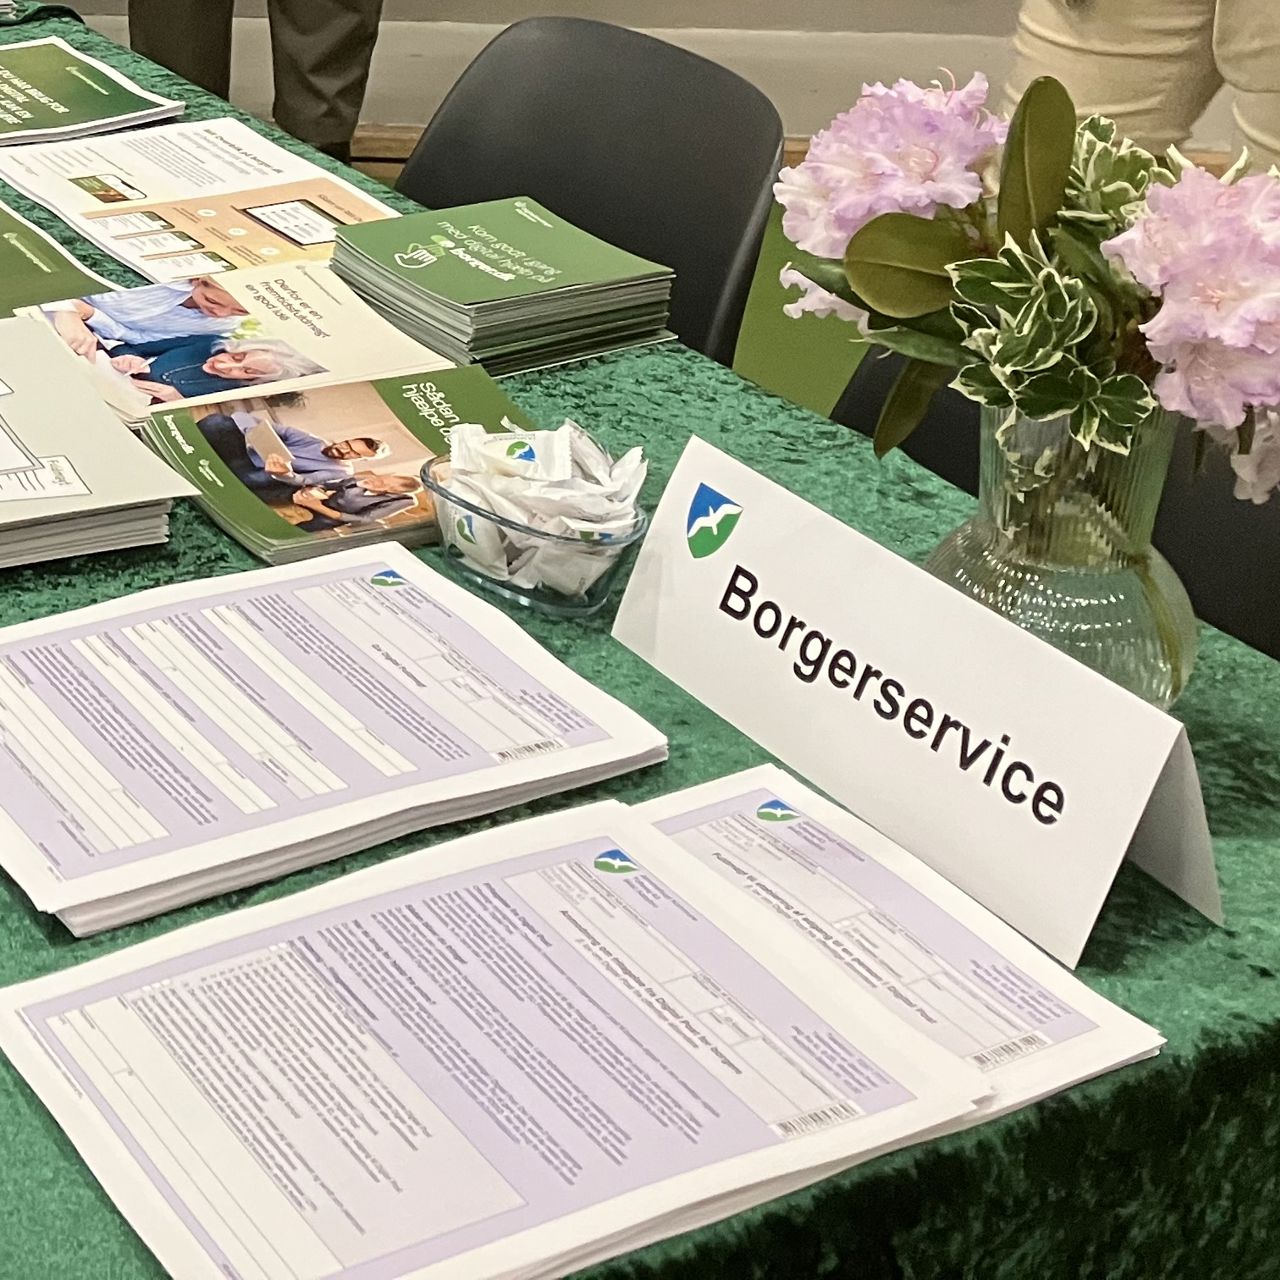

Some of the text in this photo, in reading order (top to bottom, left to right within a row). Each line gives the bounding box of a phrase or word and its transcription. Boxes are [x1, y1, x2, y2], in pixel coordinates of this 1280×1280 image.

[437, 221, 470, 239] med
[464, 239, 505, 259] digital
[467, 225, 497, 242] Kom
[490, 243, 526, 258] godt
[450, 248, 516, 281] borger.dk
[245, 284, 259, 294] en
[253, 295, 277, 309] god
[274, 279, 302, 300] Derfor
[309, 310, 323, 319] en
[402, 384, 444, 426] hjælpe
[419, 382, 460, 423] Sådan
[718, 565, 1066, 825] Borgerservice
